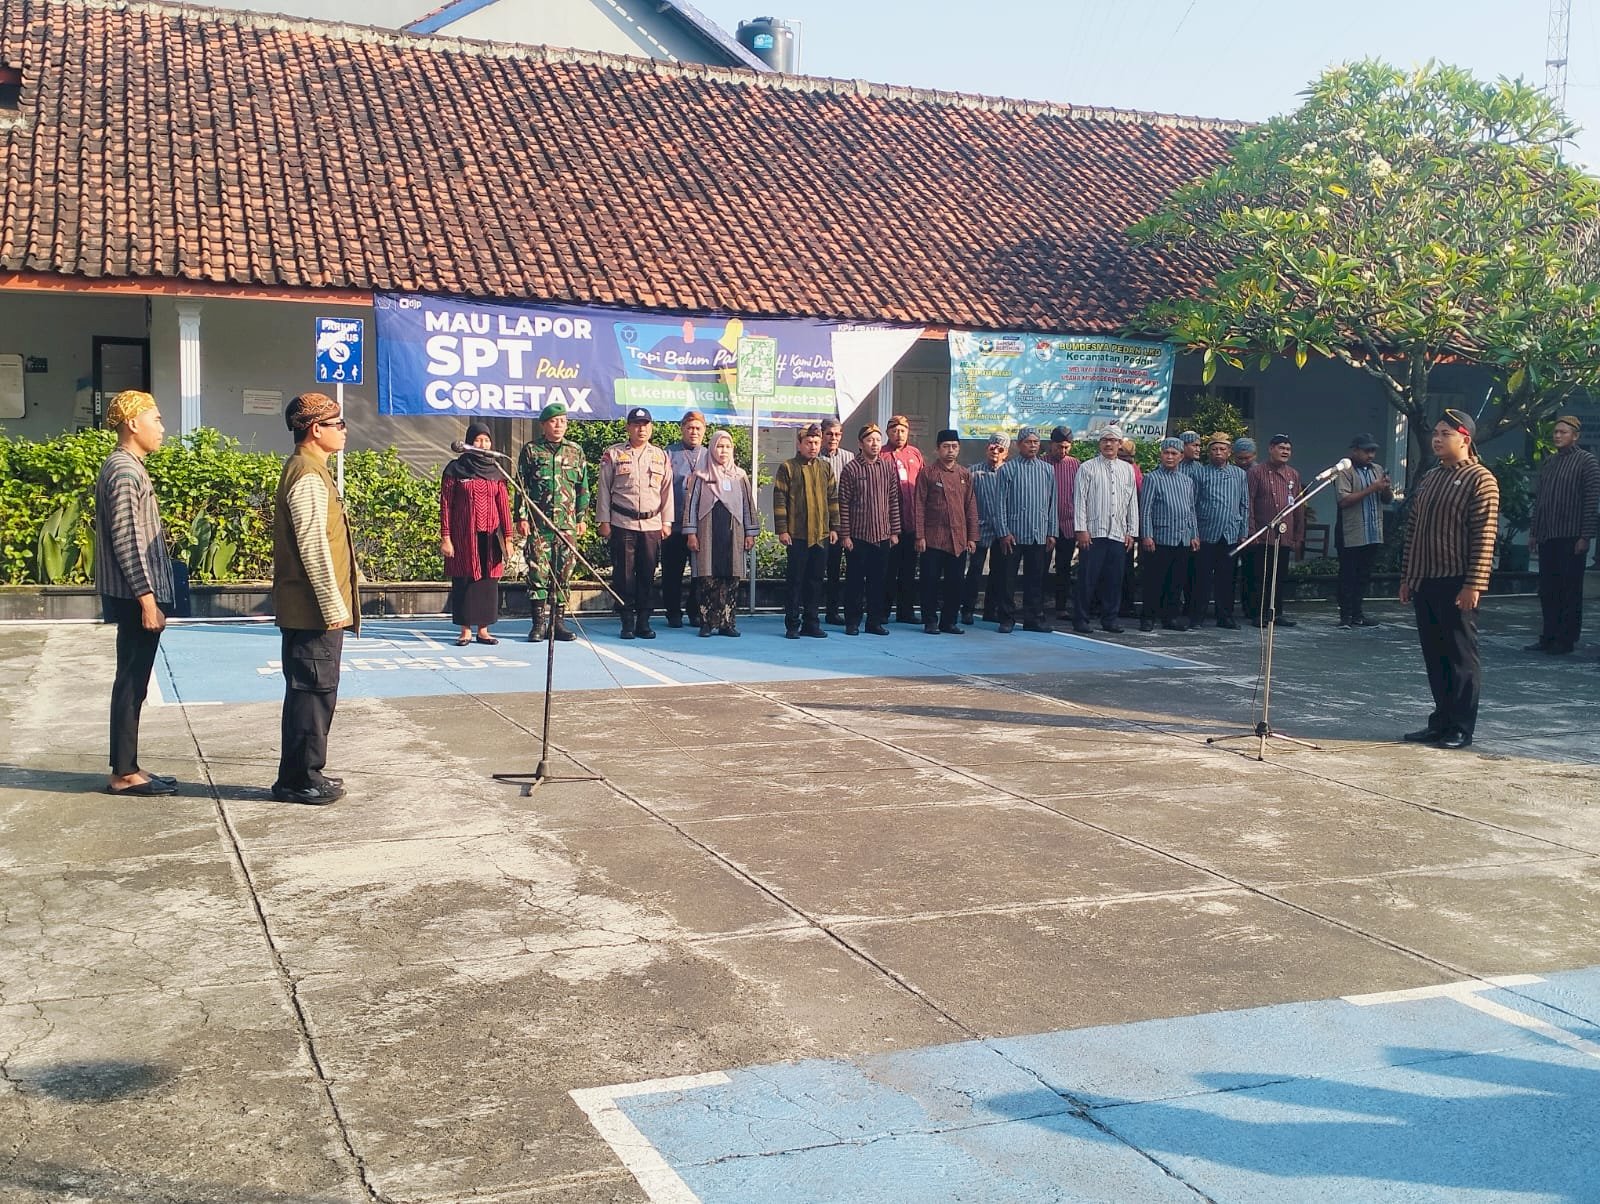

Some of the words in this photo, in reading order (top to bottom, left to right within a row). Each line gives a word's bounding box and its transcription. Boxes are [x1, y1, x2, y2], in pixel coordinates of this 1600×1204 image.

[425, 311, 490, 334] MAU
[499, 315, 592, 339] LAPOR
[426, 335, 532, 379] SPT
[625, 346, 660, 365] Tapi
[665, 350, 709, 365] Belum
[790, 354, 812, 367] Kami
[1066, 352, 1120, 362] Kecamatan
[536, 358, 580, 379] Pakai
[792, 366, 824, 381] Sampai
[425, 381, 593, 413] CORETAX
[1126, 423, 1164, 435] PANDAI
